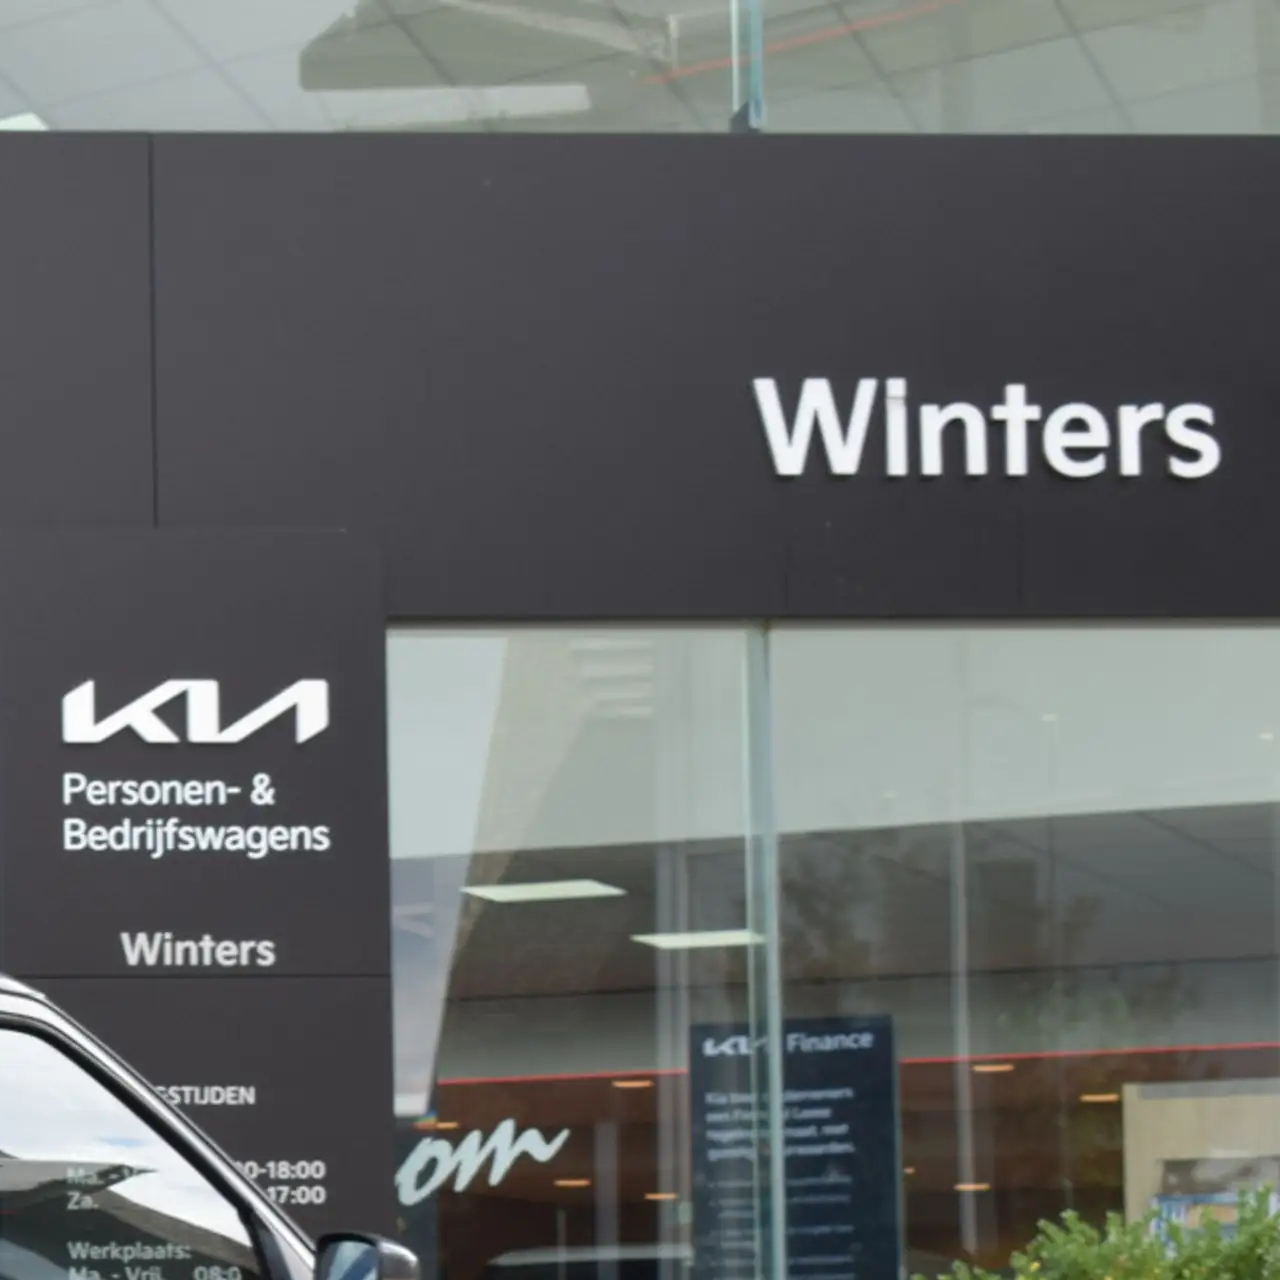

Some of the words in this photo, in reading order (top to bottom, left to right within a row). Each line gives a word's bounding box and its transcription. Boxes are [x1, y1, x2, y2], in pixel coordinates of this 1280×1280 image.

[753, 376, 1221, 478] Winters
[62, 679, 328, 744] KIA
[63, 772, 241, 806] Personen-
[250, 772, 276, 806] &
[63, 817, 330, 859] Bedrijfswagens
[121, 931, 276, 967] Winters
[786, 1031, 876, 1055] Finance
[235, 1160, 326, 1180] 0-18:00
[66, 1240, 192, 1262] Werkplaats:
